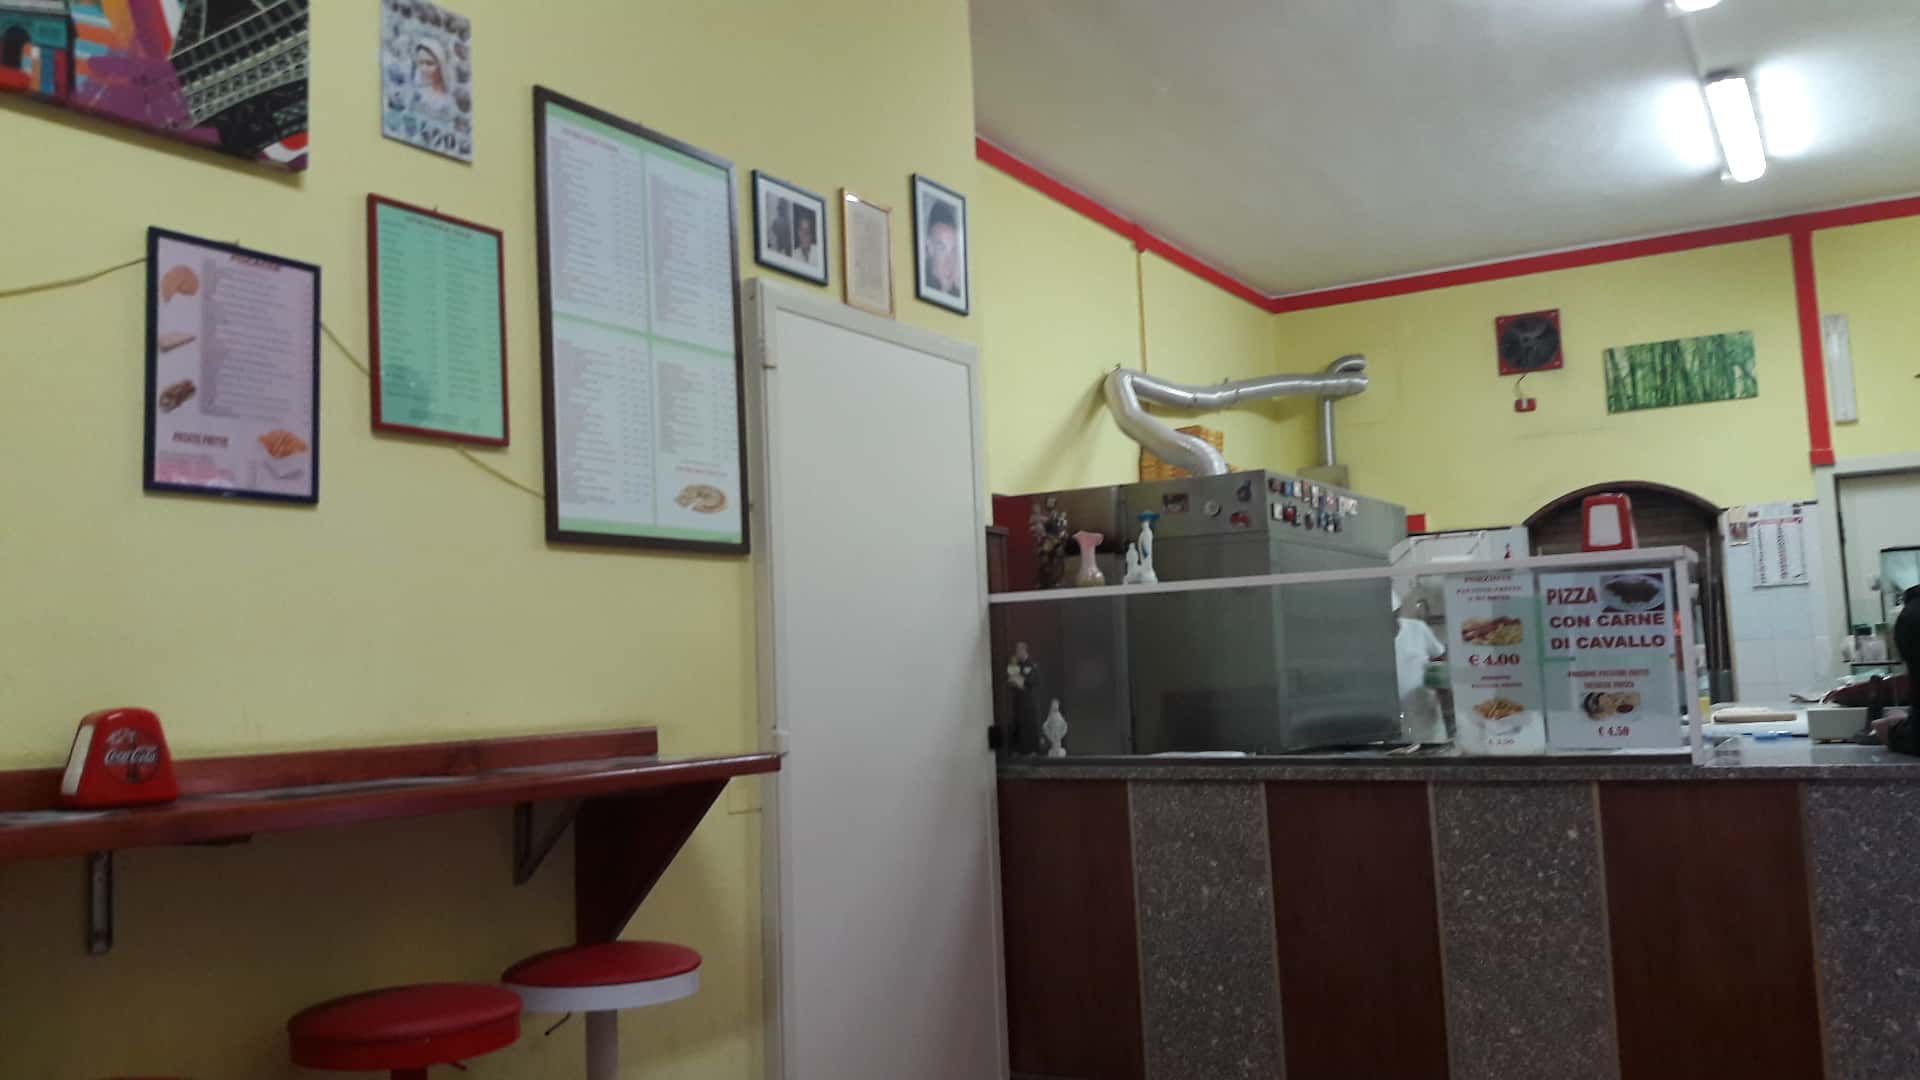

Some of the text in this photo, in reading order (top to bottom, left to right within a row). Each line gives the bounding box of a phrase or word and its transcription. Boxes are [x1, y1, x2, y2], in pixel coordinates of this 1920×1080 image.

[1546, 586, 1598, 606] PIZZA
[1549, 612, 1665, 629] CON CARNE
[1551, 634, 1666, 650] DI CAVALLO
[1482, 653, 1521, 666] 4.00
